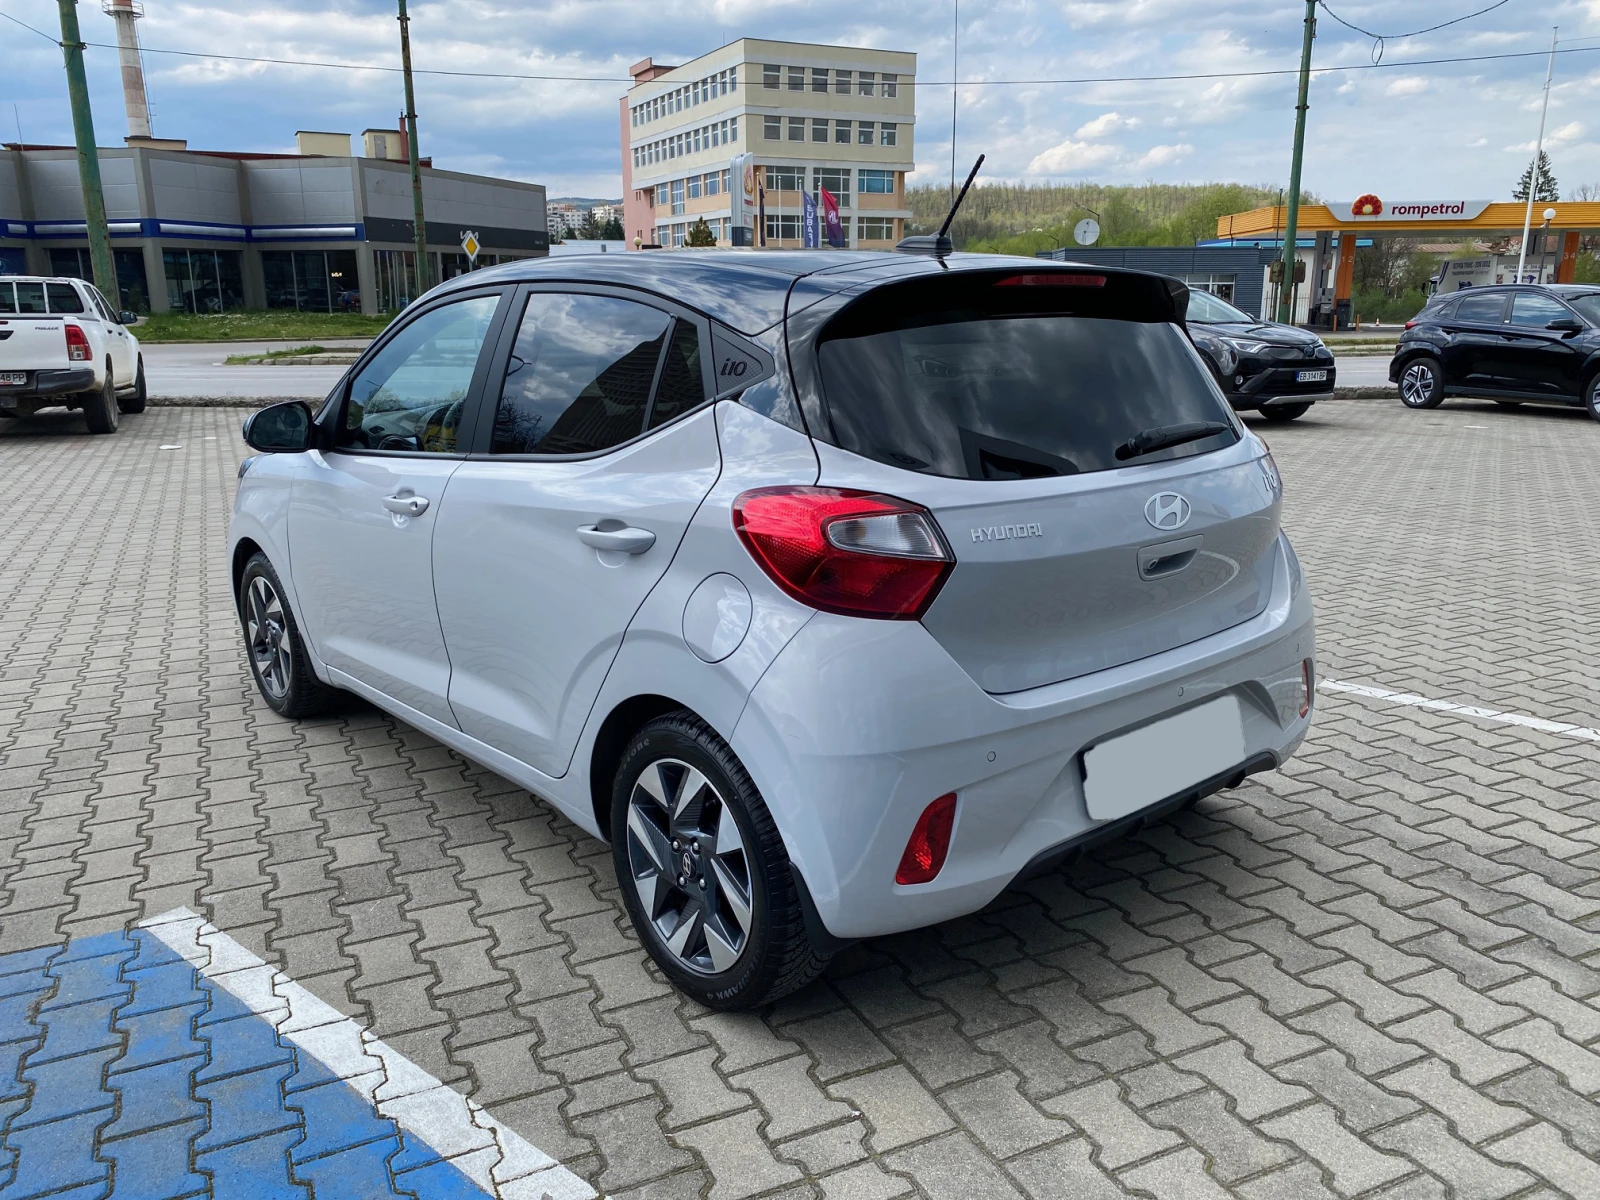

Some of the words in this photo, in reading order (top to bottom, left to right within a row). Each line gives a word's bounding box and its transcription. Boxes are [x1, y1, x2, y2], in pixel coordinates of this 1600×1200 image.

[1391, 201, 1465, 219] rompetrol
[720, 357, 748, 377] i10
[970, 522, 1043, 543] HYUNDAI
